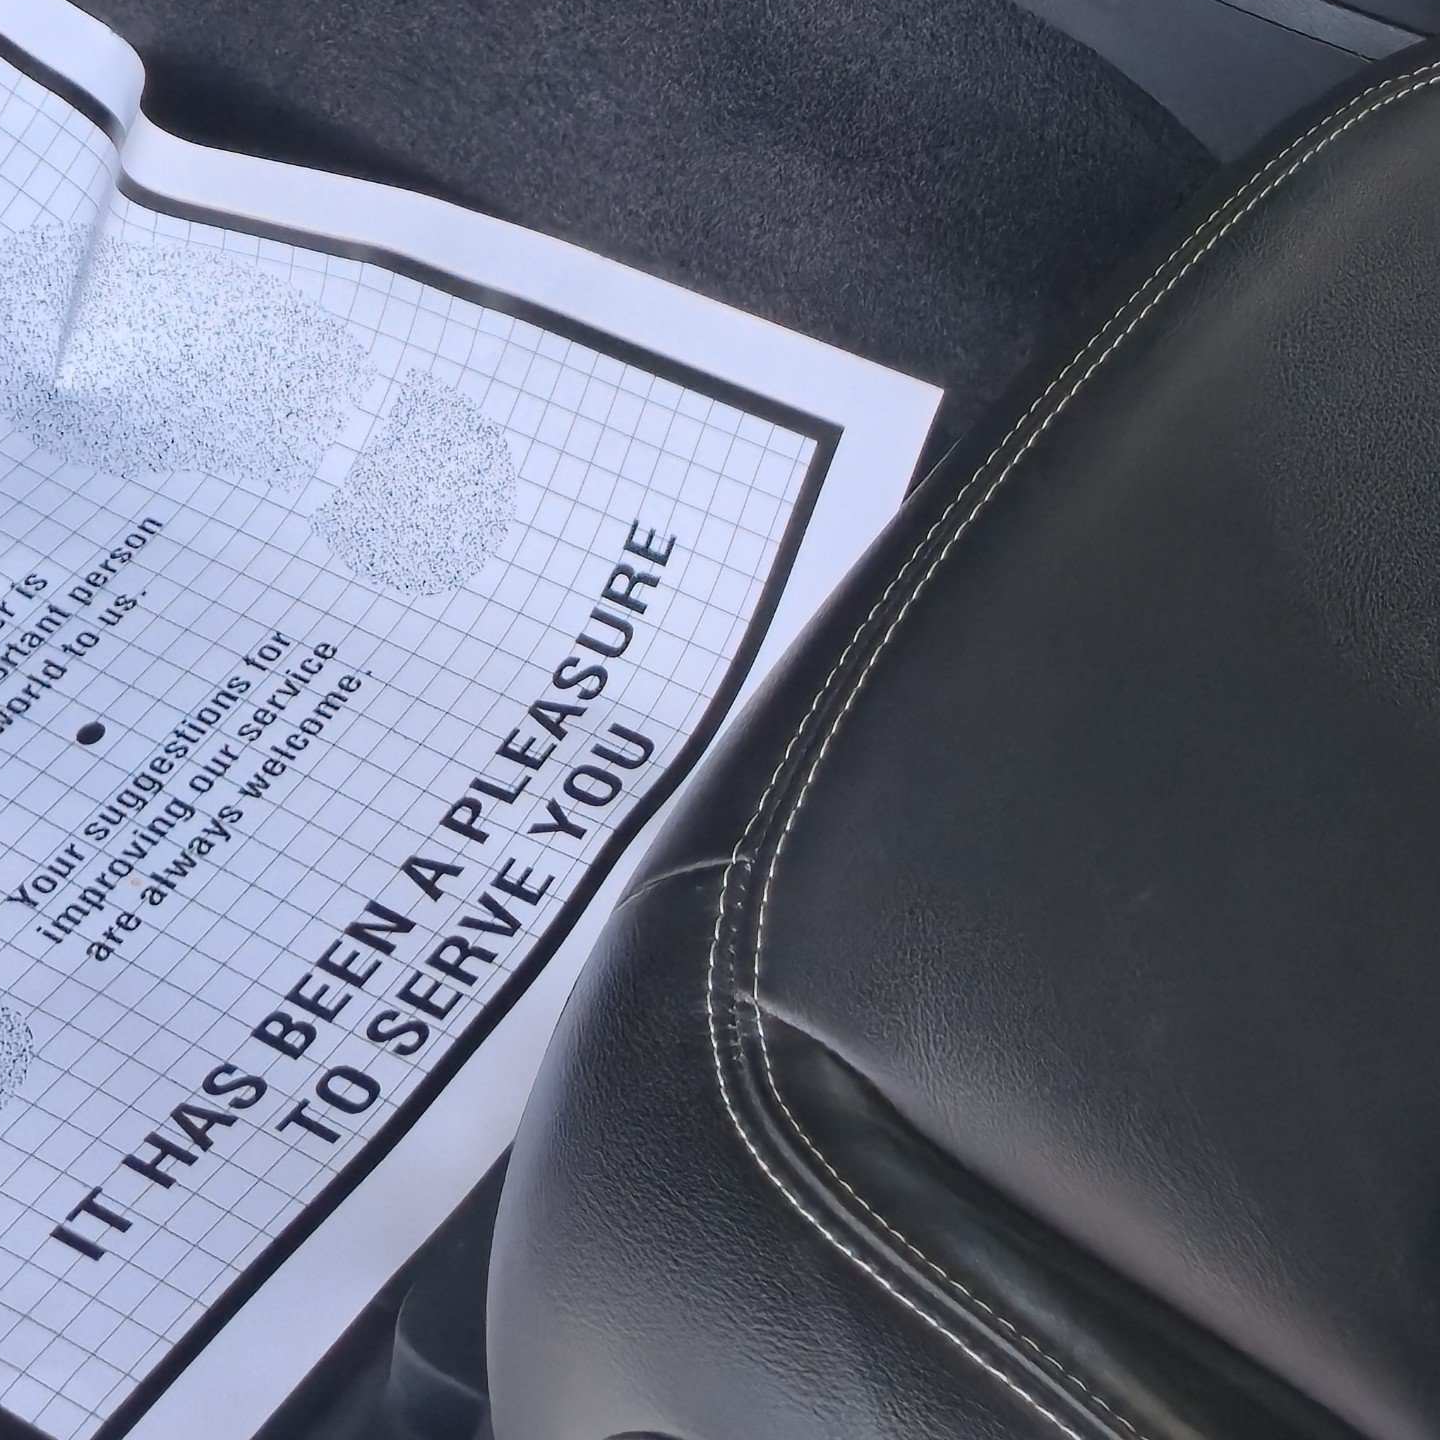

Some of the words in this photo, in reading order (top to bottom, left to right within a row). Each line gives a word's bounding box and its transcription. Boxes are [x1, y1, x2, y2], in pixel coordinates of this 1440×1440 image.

[10, 572, 50, 600] is
[61, 628, 101, 658] to
[97, 590, 148, 628] us.
[68, 515, 163, 607] person
[7, 842, 86, 911] Your
[83, 674, 252, 841] suggestions
[242, 630, 292, 672] for
[36, 796, 197, 945] improving
[188, 743, 241, 794] our
[237, 640, 338, 742] service
[49, 1185, 133, 1262] IT
[122, 1062, 269, 1190] HAS
[250, 899, 418, 1061] BEEN
[401, 853, 465, 902] A
[438, 518, 678, 845] PLEASURE
[85, 909, 143, 963] are
[140, 804, 244, 907] always
[238, 669, 373, 801] welcome.
[274, 1064, 382, 1145] TO
[366, 856, 556, 1058] SERVE
[526, 722, 656, 840] YOU
